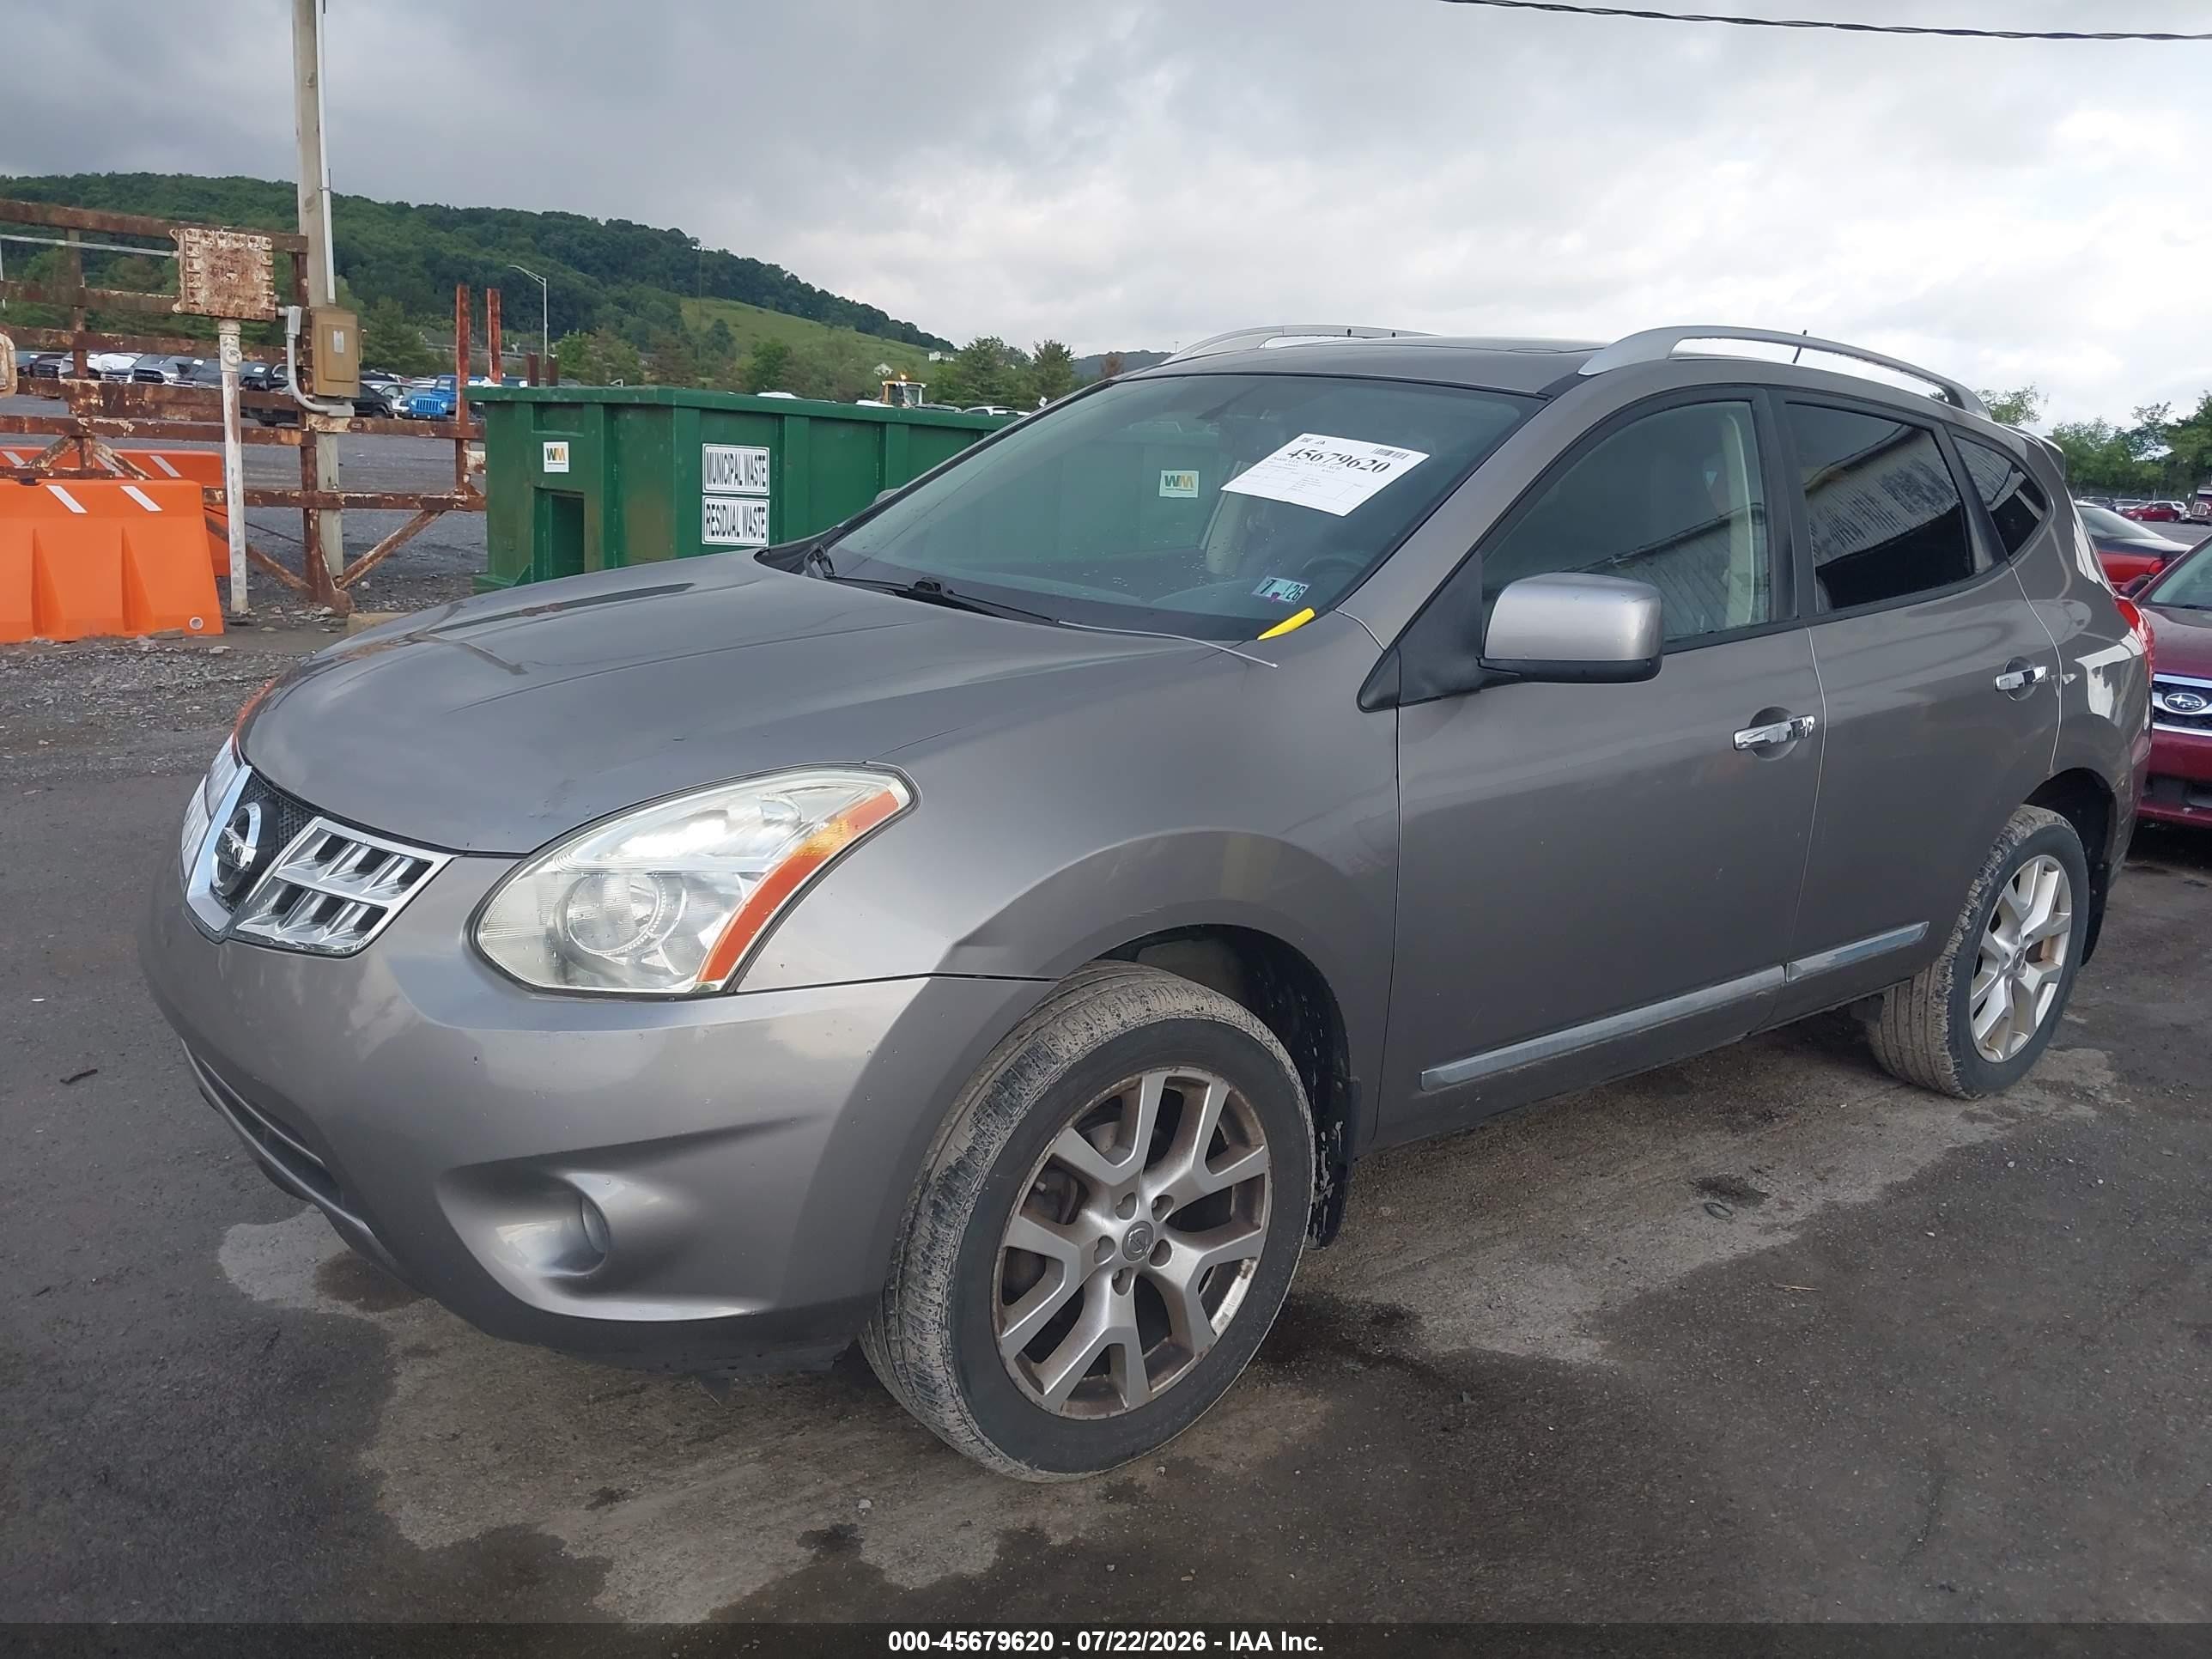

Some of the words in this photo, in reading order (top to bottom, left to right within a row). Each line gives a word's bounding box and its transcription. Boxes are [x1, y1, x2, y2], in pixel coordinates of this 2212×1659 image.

[546, 447, 566, 461] WM
[1287, 448, 1391, 473] 45679620
[707, 452, 743, 486] MUNICIPAL
[744, 453, 766, 488] WASTE
[1164, 475, 1194, 489] WM
[706, 503, 740, 538] RESIDUAL
[742, 505, 765, 539] WASTE
